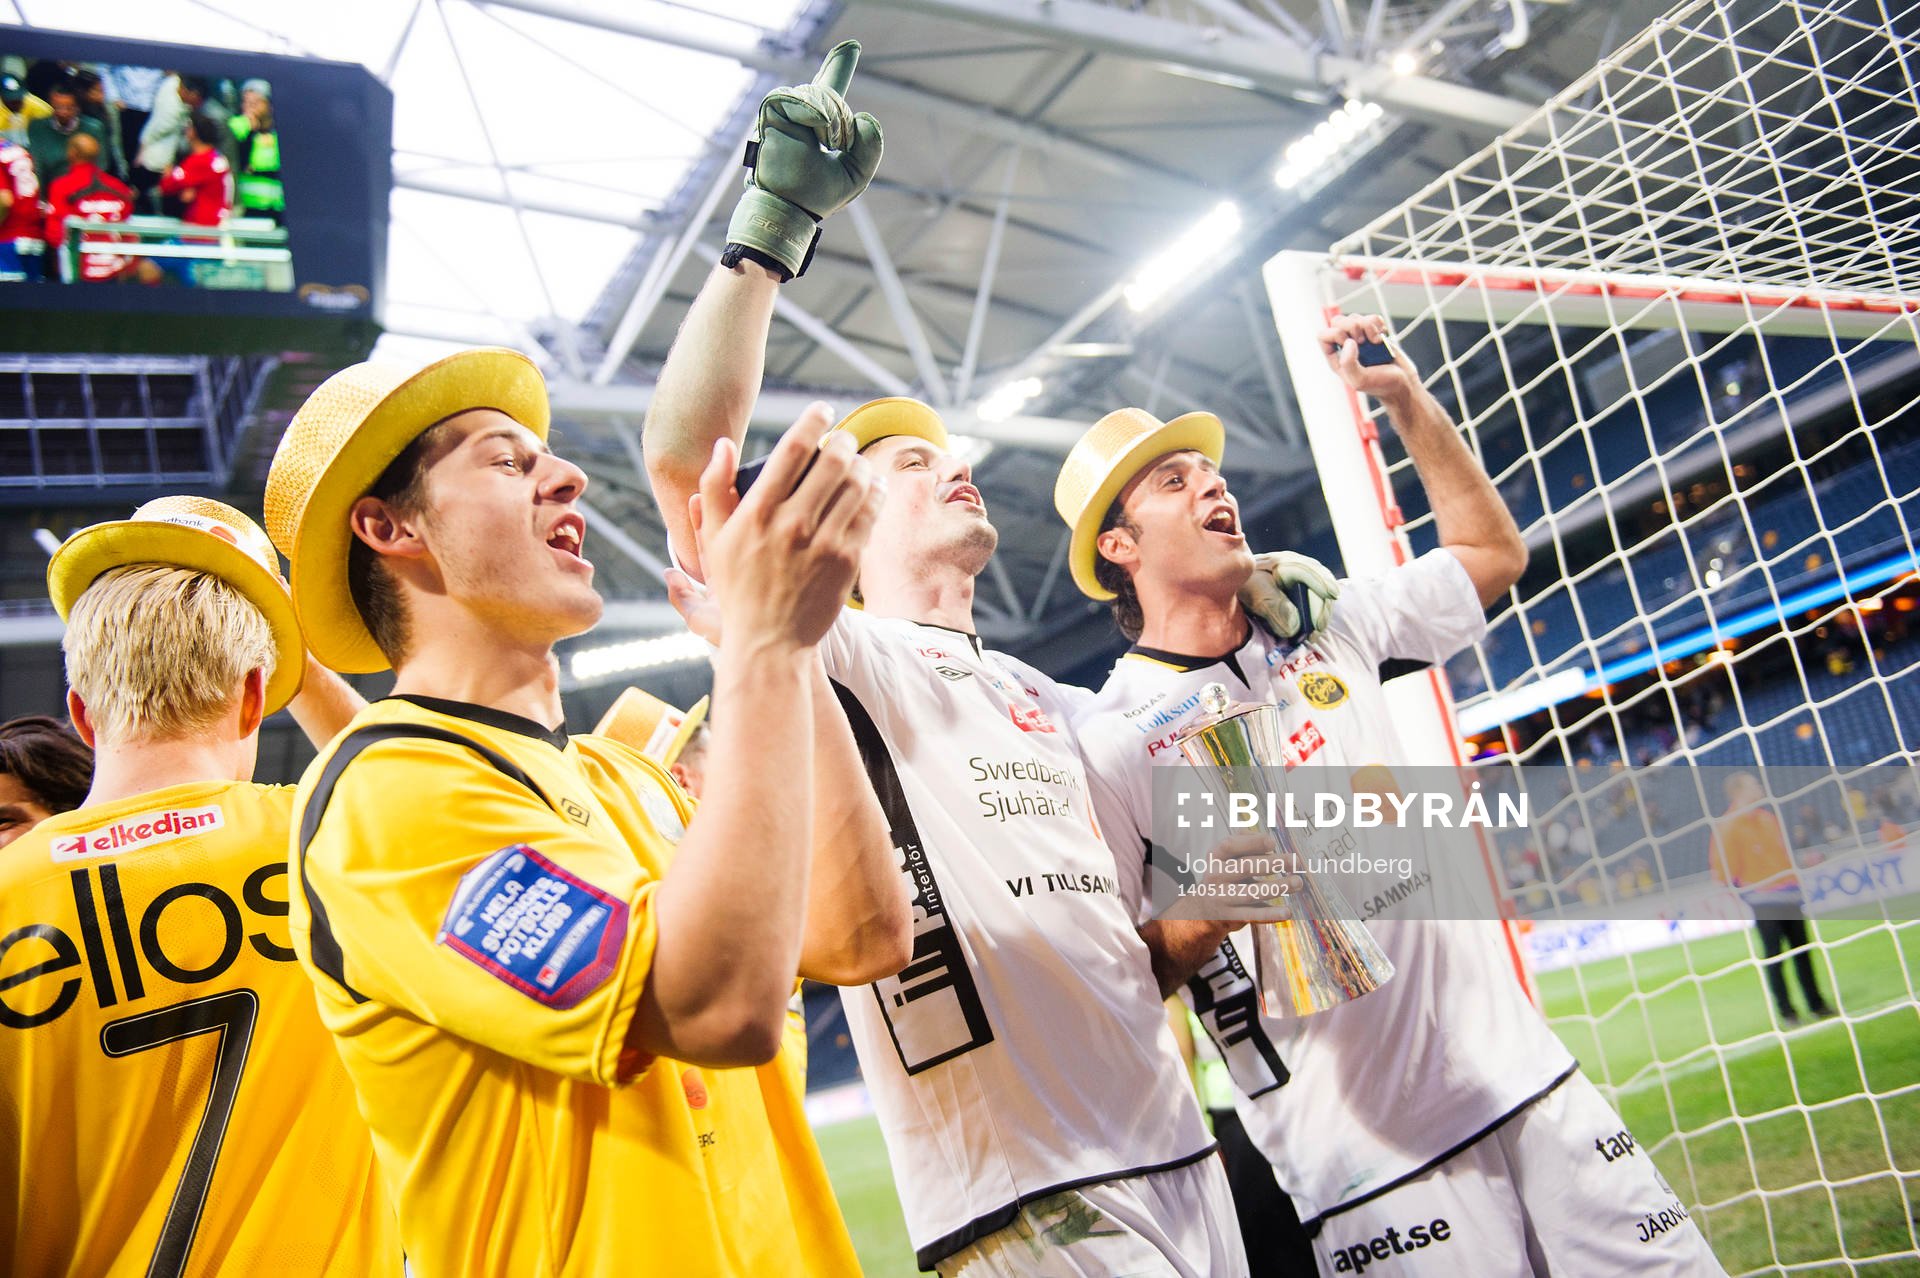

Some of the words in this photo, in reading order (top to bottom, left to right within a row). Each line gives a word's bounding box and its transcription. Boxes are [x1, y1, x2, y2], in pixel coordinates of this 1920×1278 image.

[968, 756, 1081, 792] Swedbank
[978, 789, 1074, 823] Sjuhärad
[92, 808, 217, 852] elkedjan
[906, 842, 940, 916] interiör
[1005, 876, 1035, 898] VI
[479, 880, 526, 925] HELA
[0, 861, 299, 1030] ellos
[99, 986, 260, 1278] 7
[1329, 1217, 1452, 1276] apet.se
